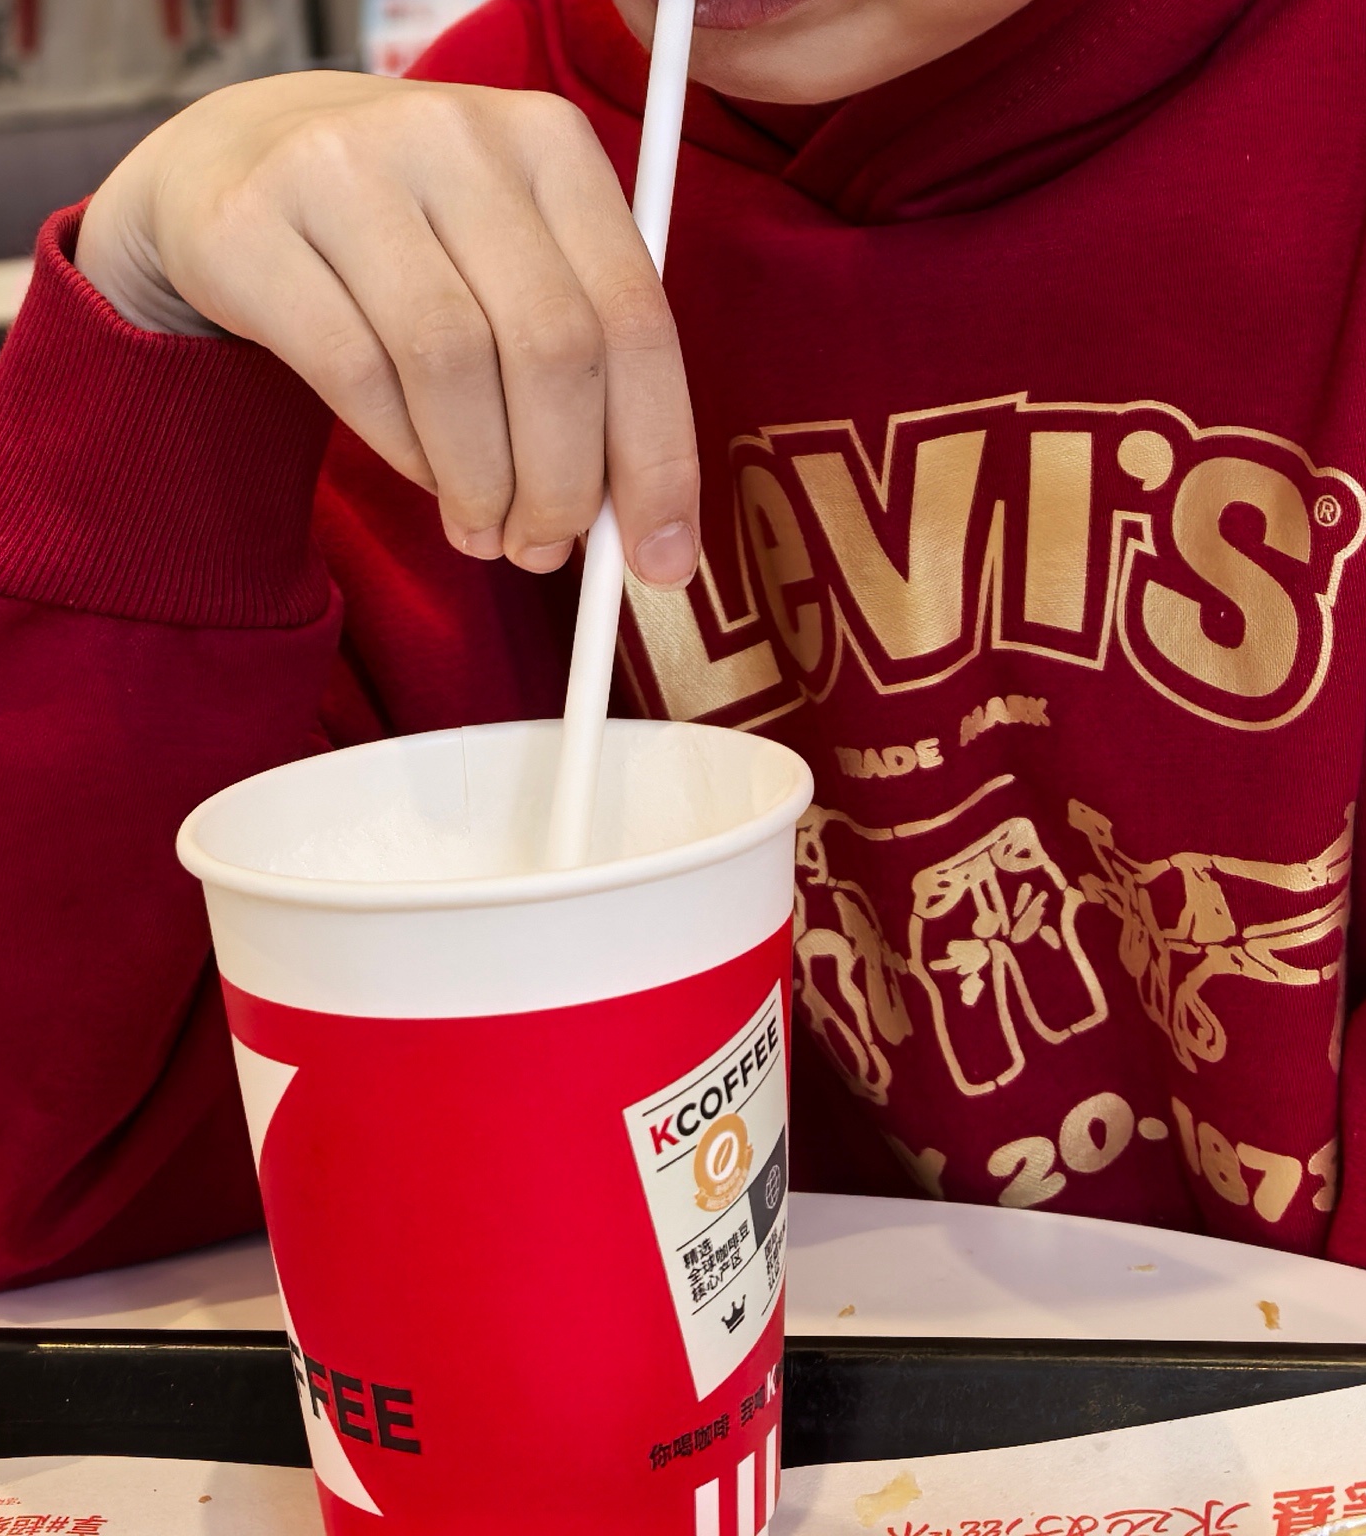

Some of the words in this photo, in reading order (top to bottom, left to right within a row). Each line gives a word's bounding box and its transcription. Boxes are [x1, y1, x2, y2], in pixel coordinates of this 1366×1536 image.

[649, 1015, 779, 1155] KCOFFEE
[688, 1219, 750, 1287] 全球咖啡豆
[692, 1247, 743, 1303] 核心产区
